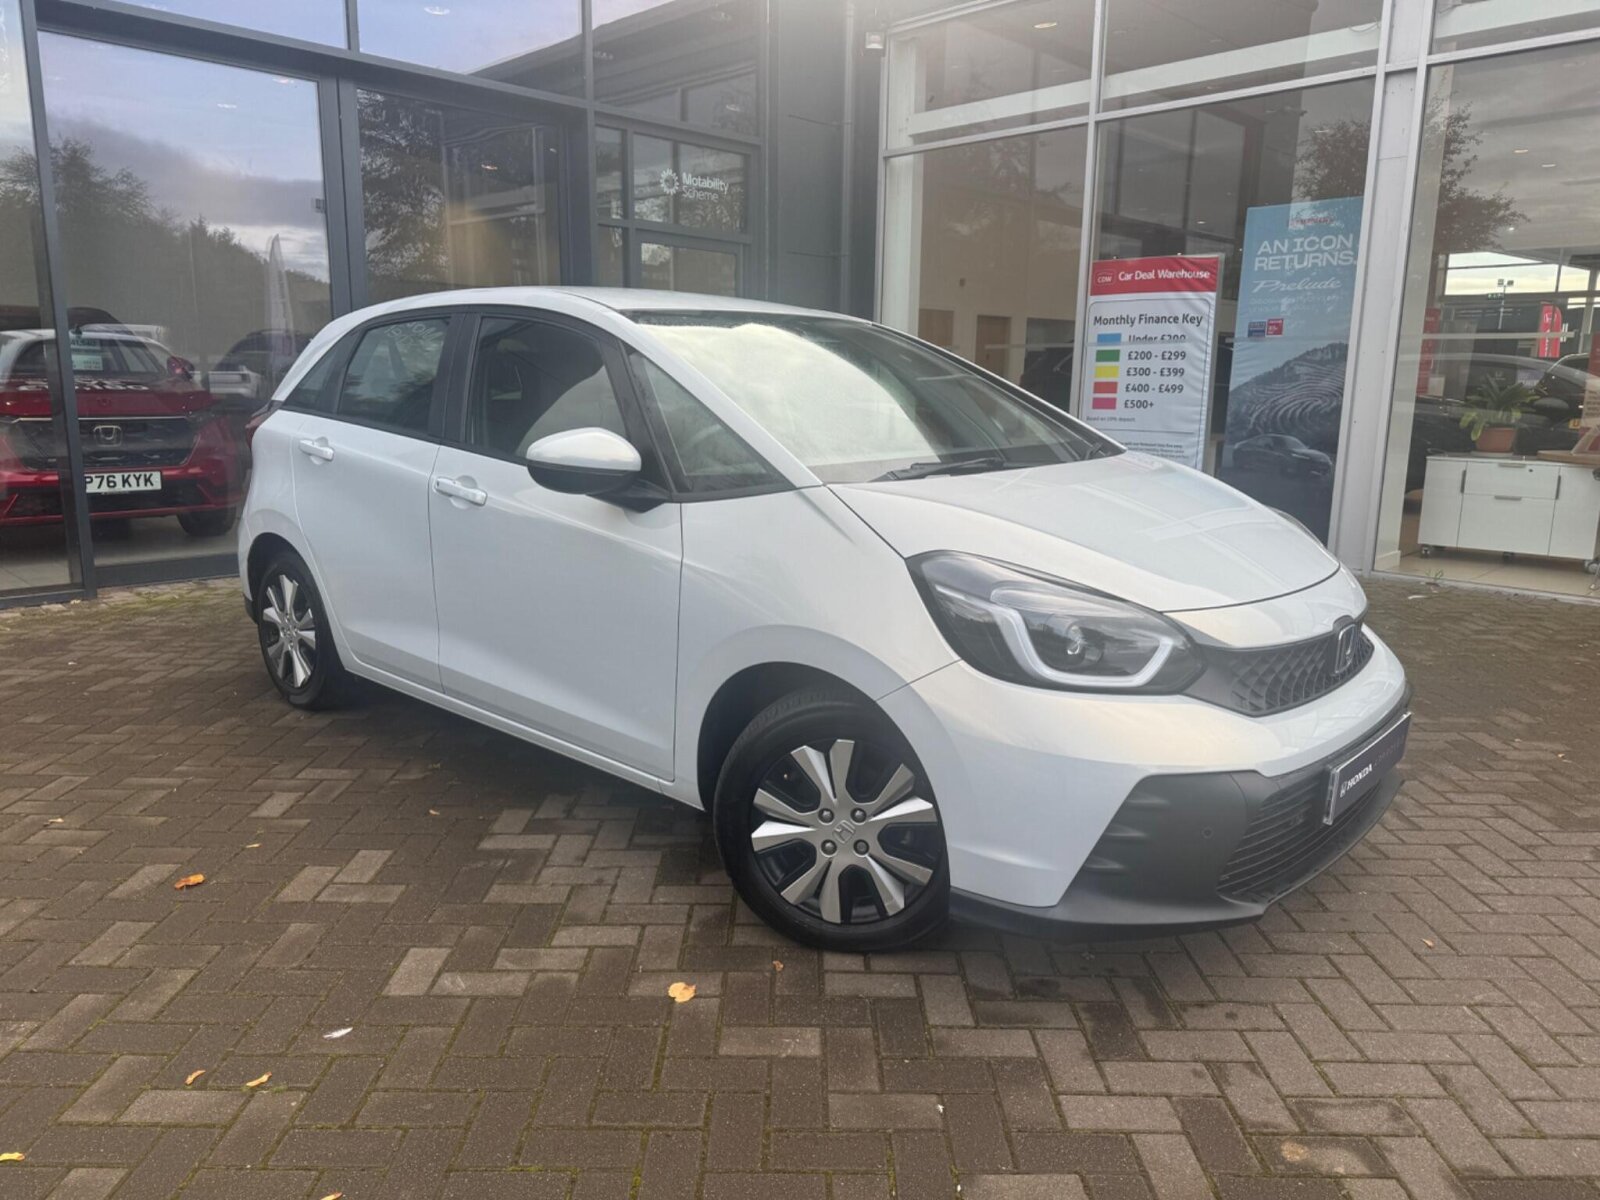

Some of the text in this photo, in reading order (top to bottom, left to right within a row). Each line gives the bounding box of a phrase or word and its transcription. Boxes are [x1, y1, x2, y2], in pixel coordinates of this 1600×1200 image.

[682, 172, 729, 194] Motability
[682, 186, 719, 202] Scheme
[1257, 234, 1353, 255] AN ICON
[1097, 273, 1112, 283] CDW
[1118, 268, 1211, 281] Car Deal Warehouse
[1252, 277, 1342, 293] Prelude
[1093, 313, 1204, 328] Monthly Finance Key
[1128, 334, 1158, 342] Under
[1127, 350, 1152, 360] £200
[1161, 350, 1186, 361] £299
[1126, 367, 1151, 376] £300
[1160, 367, 1185, 377] £399
[1125, 383, 1150, 393] £400
[1158, 383, 1184, 394] £499
[1124, 399, 1154, 409] £500+
[84, 473, 154, 489] P76 KYK
[1346, 763, 1373, 790] HONDA
